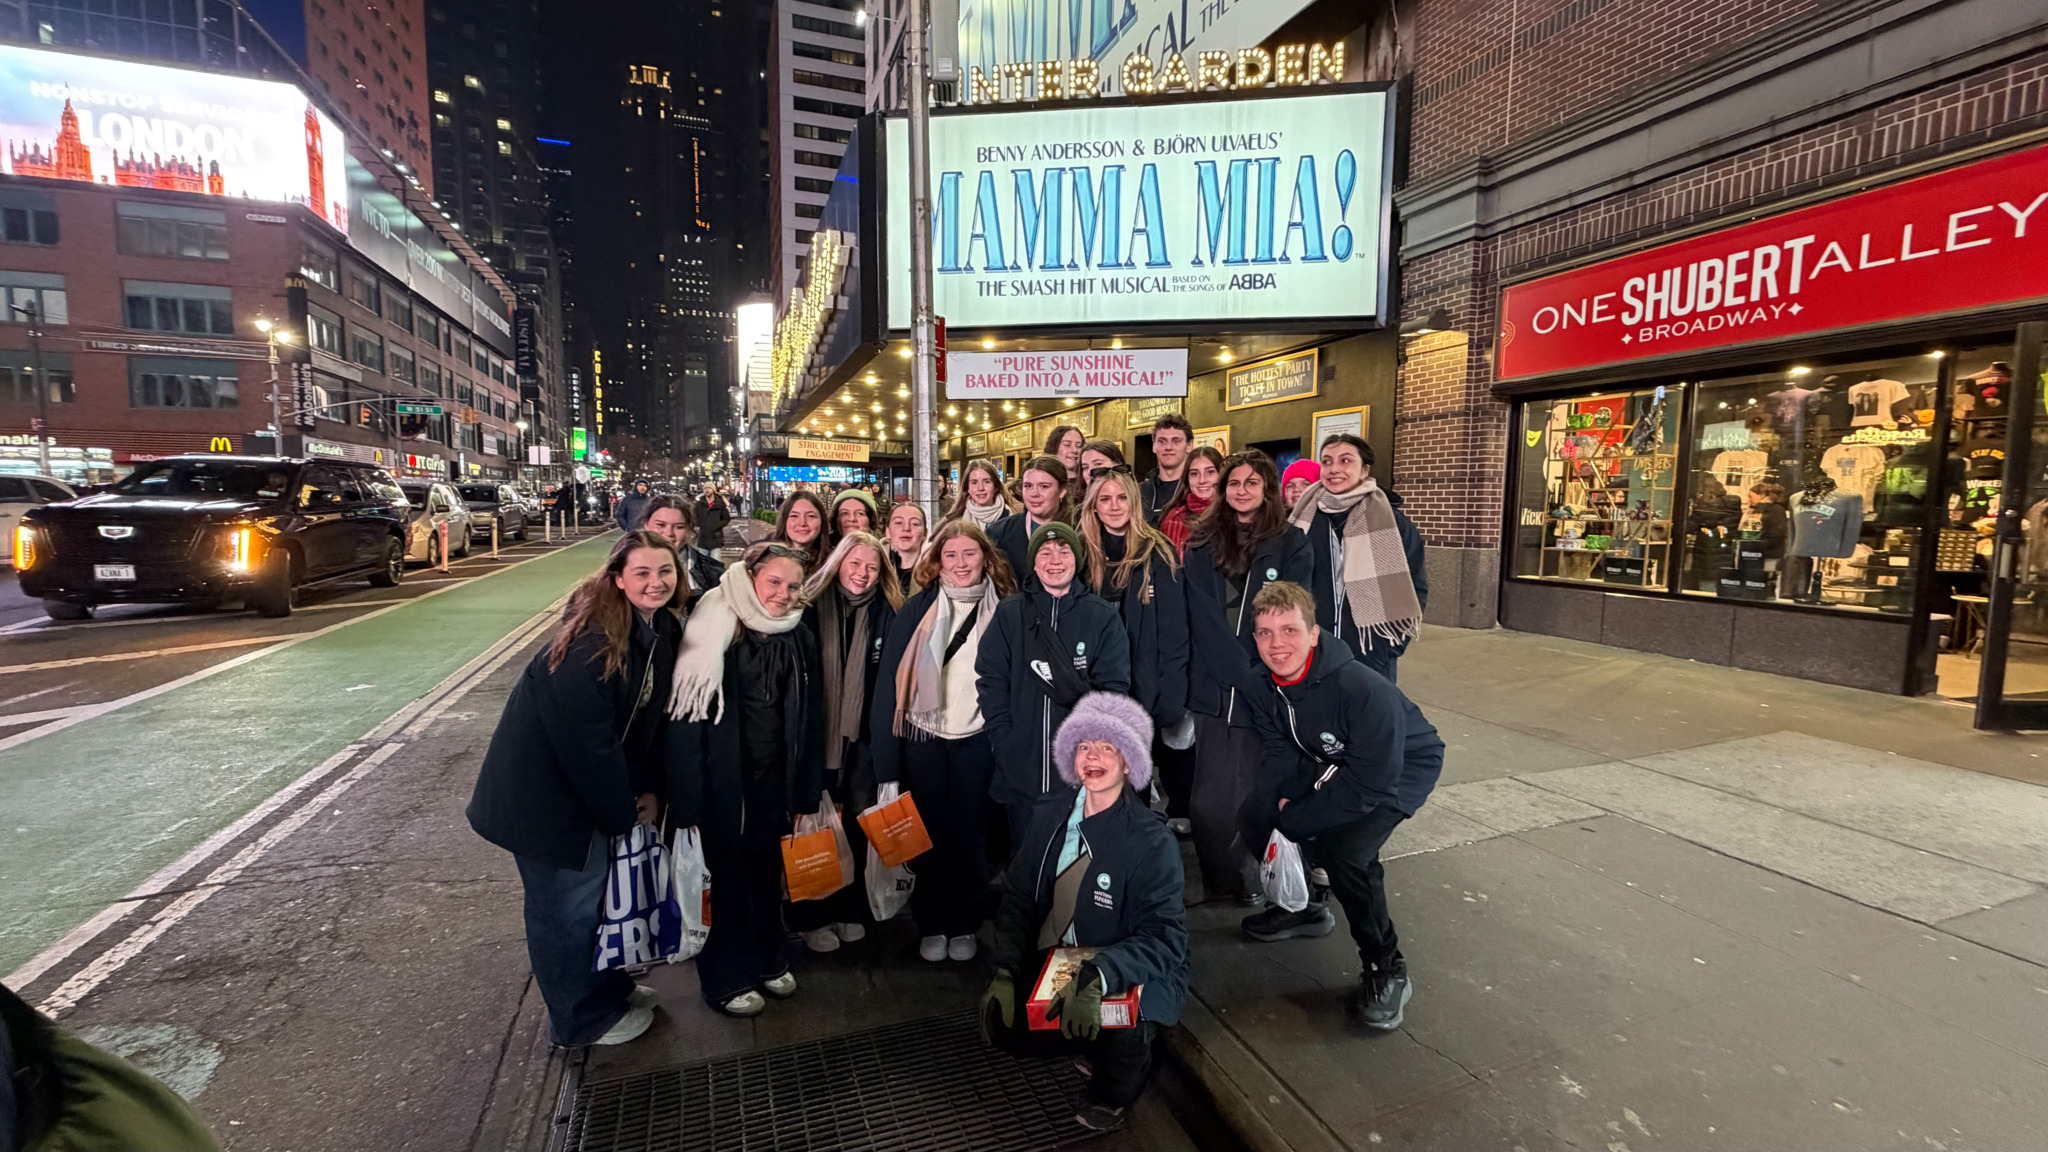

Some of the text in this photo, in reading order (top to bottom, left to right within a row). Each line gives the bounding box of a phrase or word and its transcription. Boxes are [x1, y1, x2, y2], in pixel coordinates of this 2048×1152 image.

[1122, 41, 1344, 96] GARDEN
[30, 80, 154, 110] NONSTOP
[77, 108, 254, 164] LONDON
[977, 145, 1027, 163] BENNY
[1031, 140, 1125, 162] ANDERSSON
[1132, 139, 1145, 157] &
[1154, 134, 1206, 155] BJÖRN
[1191, 149, 1357, 267] MIA!
[1532, 192, 2048, 334] ONE SHUBERT ALLEY
[976, 276, 1170, 297] THE SMASH HIT MUSICAL
[1172, 283, 1226, 293] THE SONGS OF
[1199, 275, 1210, 283] ON
[1228, 273, 1277, 290] ABBA
[1639, 303, 1787, 342] BROADWAY
[1051, 355, 1134, 371] SUNSHINE
[1251, 366, 1284, 384] HOTTEST
[1285, 359, 1312, 376] PARTY
[965, 374, 1019, 389] BAKED
[1025, 373, 1063, 388] INTO
[1068, 373, 1080, 387] A
[1240, 384, 1264, 398] TICKET
[1266, 381, 1275, 392] IN
[301, 363, 315, 426] McDonald's
[594, 350, 604, 436] COLBERT
[0, 434, 57, 446] nalds
[308, 443, 344, 457] McDonald's
[798, 440, 861, 452] STRICTLY LIMITED
[806, 450, 854, 460] ENGAGEMENT
